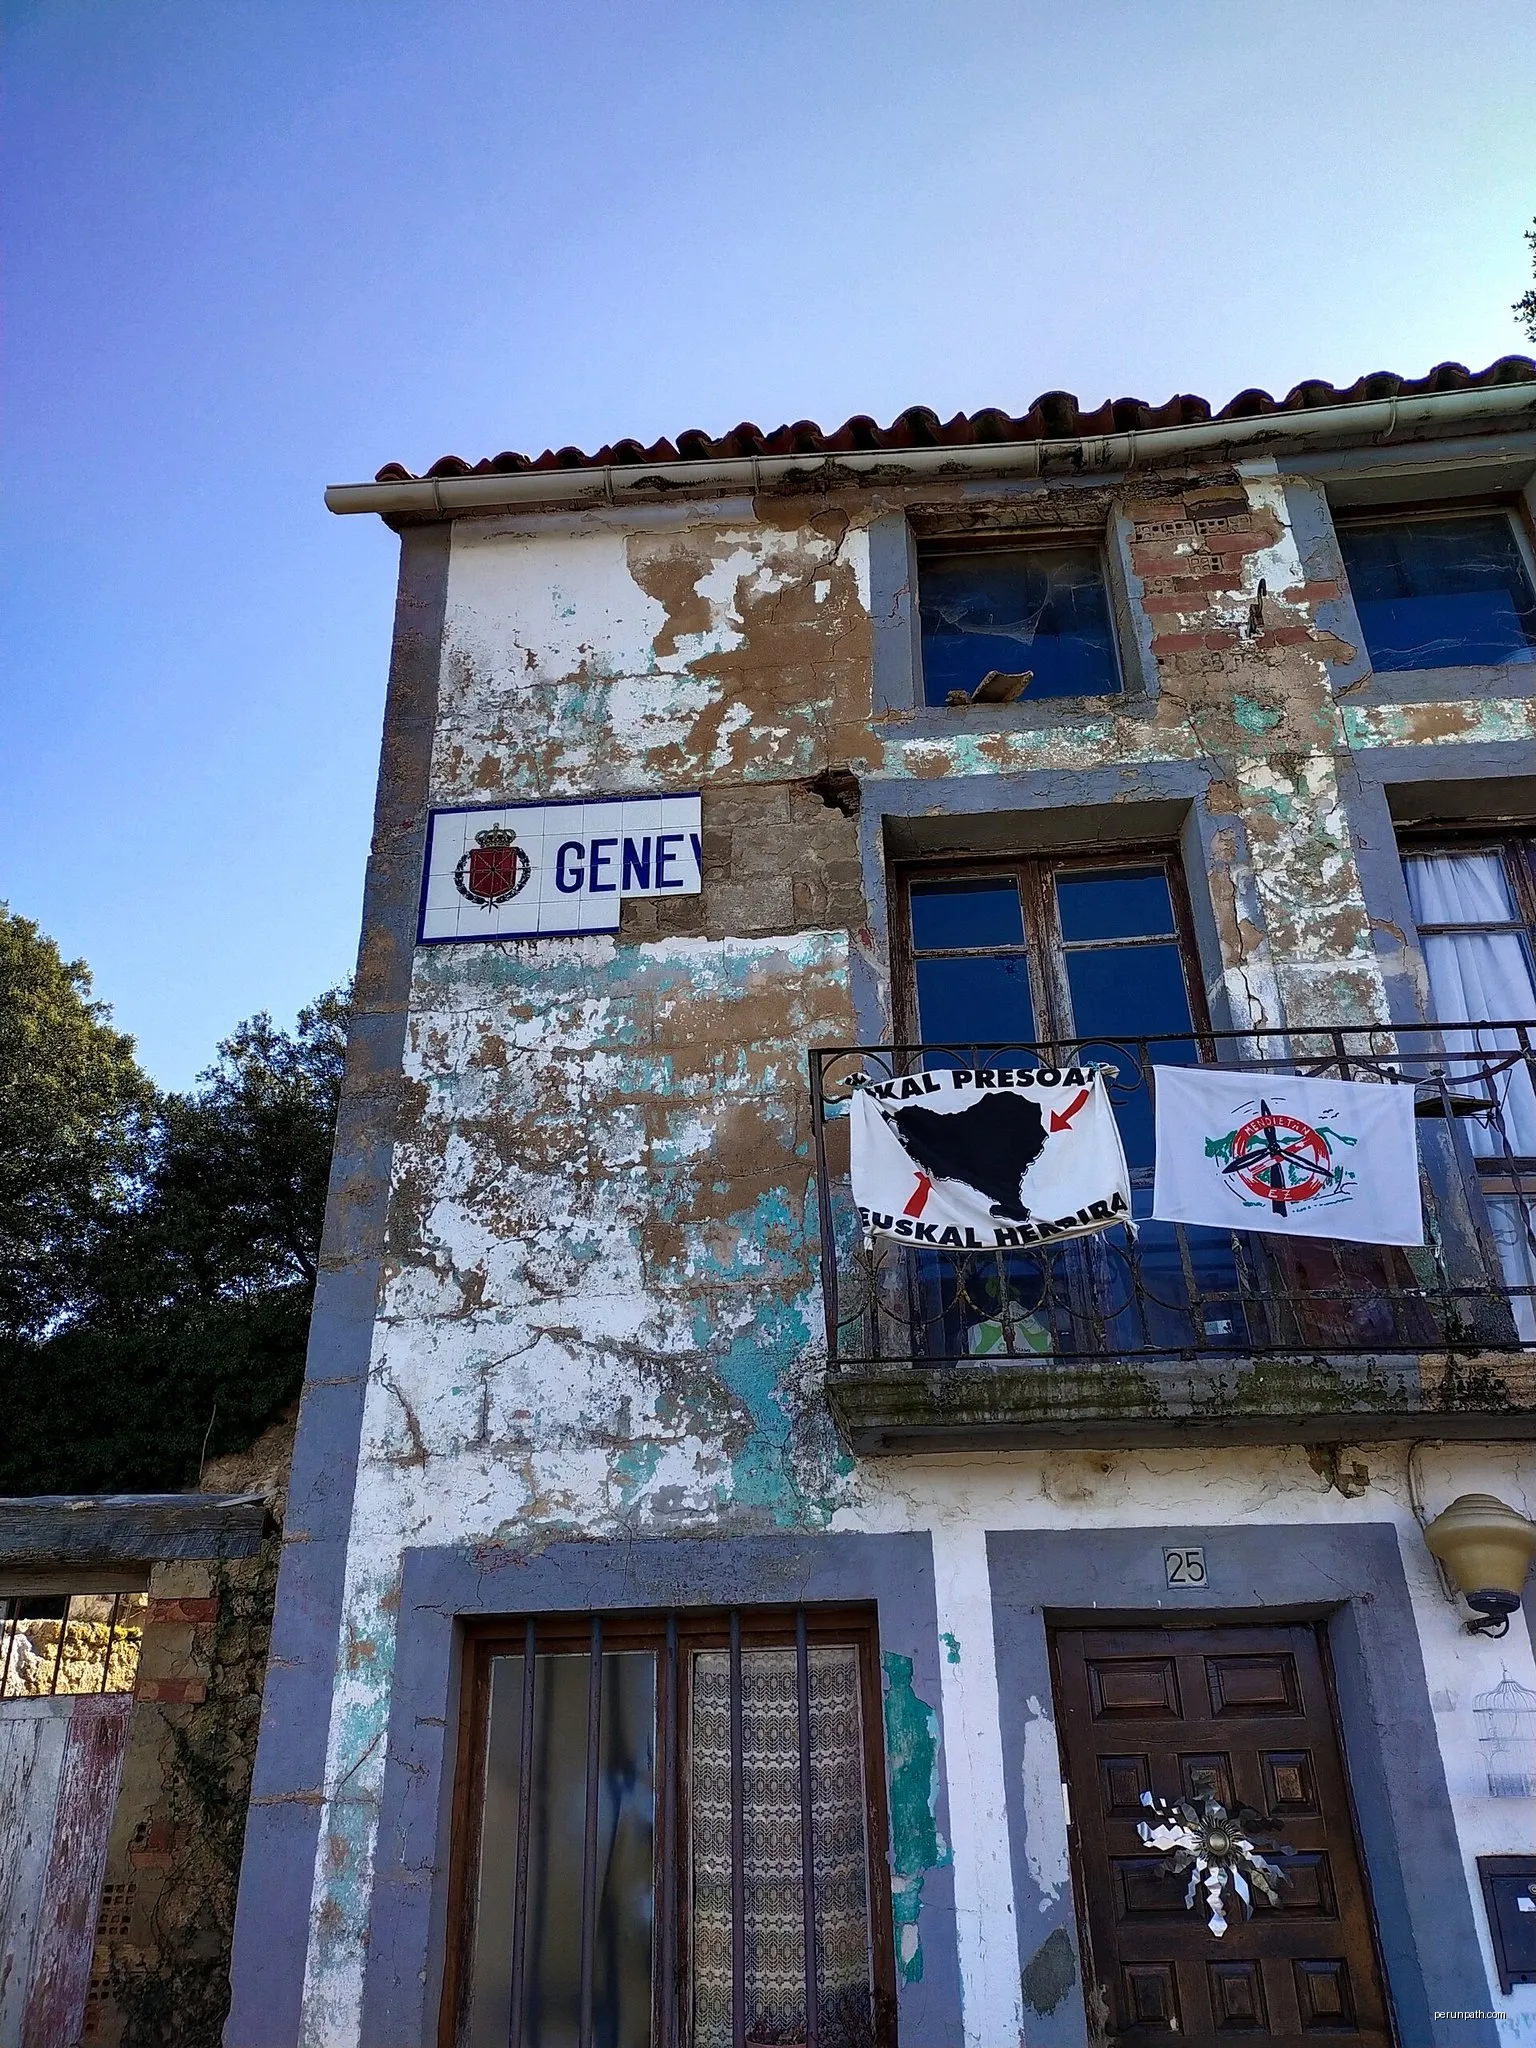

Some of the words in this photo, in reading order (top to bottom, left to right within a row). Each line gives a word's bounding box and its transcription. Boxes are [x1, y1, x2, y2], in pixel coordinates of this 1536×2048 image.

[1244, 1117, 1311, 1136] MENDIETAN
[1268, 1189, 1292, 1200] EZ
[858, 1206, 983, 1248] EUSKAL
[1166, 1551, 1205, 1583] 25
